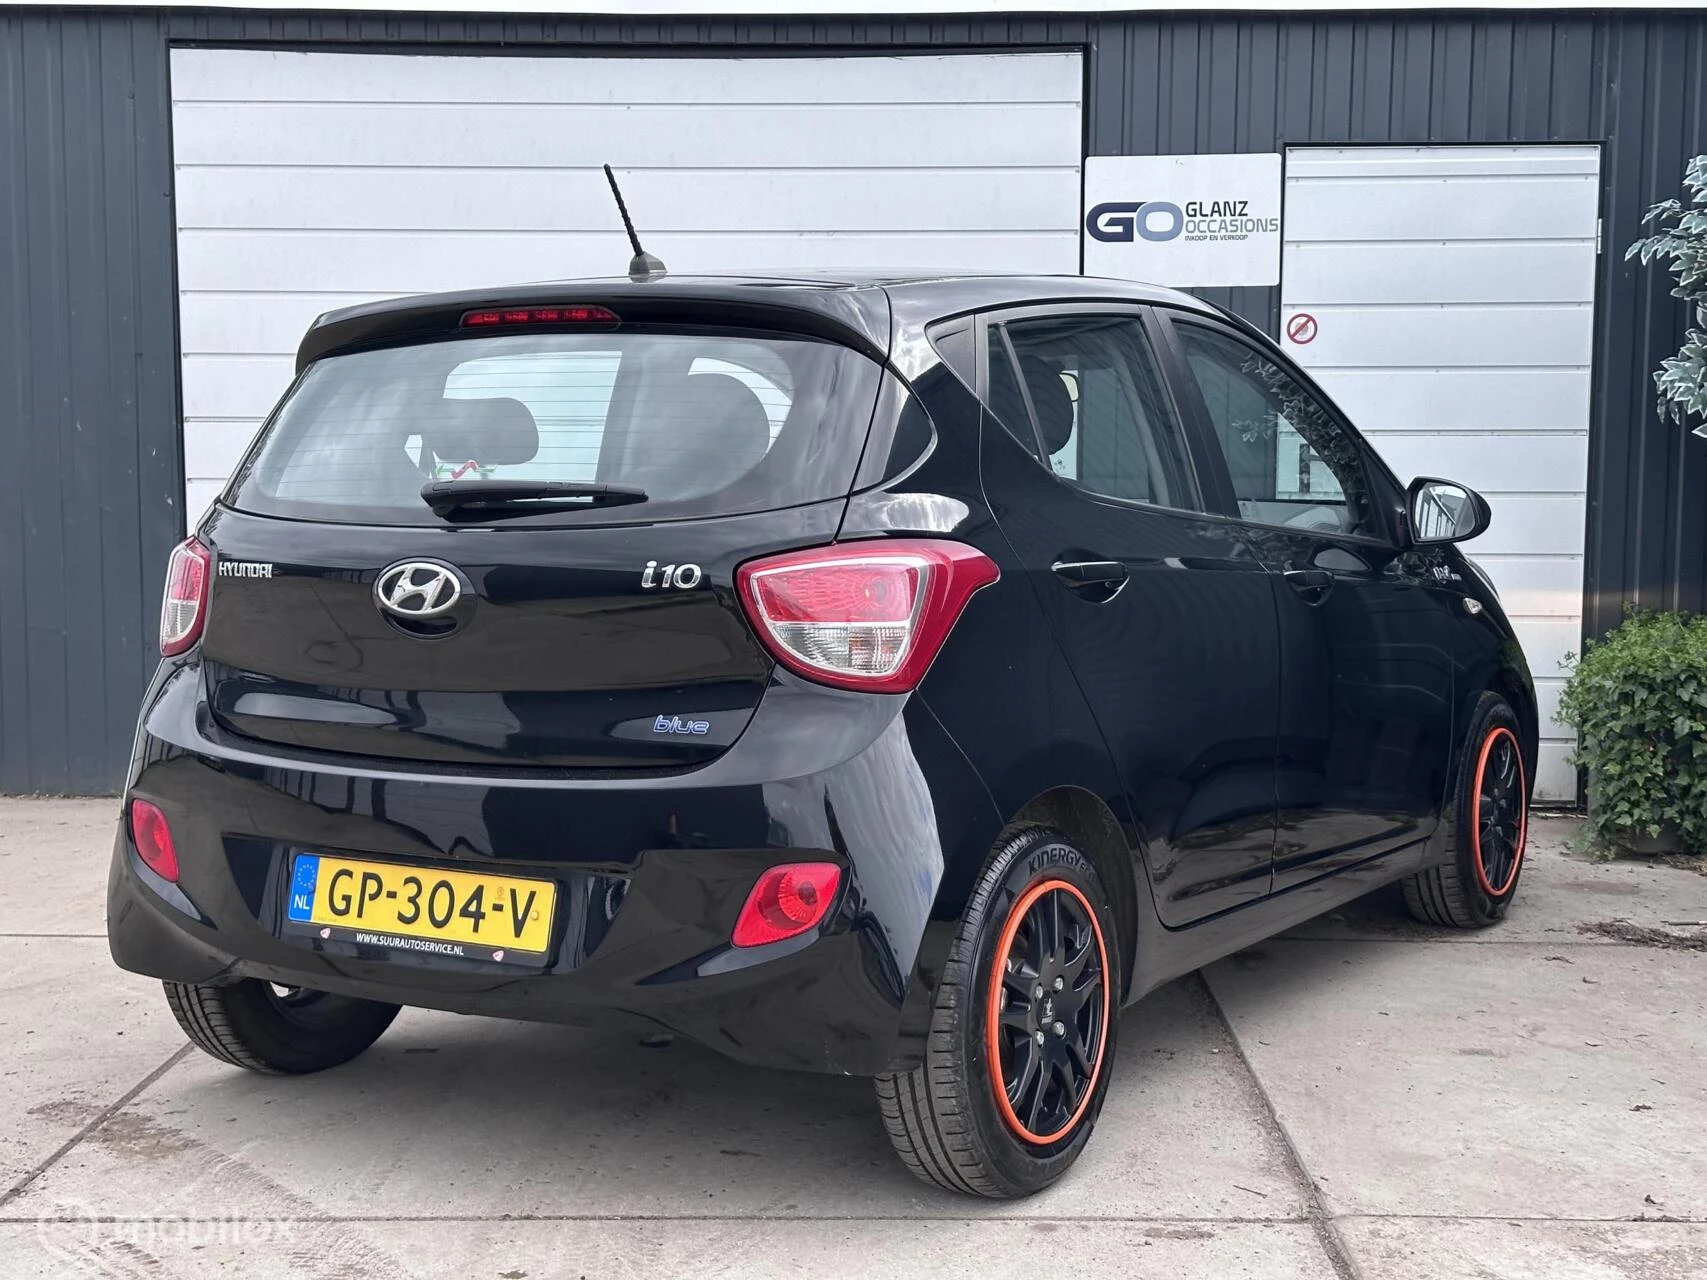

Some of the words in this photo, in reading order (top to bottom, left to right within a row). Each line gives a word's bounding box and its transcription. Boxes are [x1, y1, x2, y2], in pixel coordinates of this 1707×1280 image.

[1185, 201, 1249, 217] GLANZ
[1086, 201, 1184, 242] GO
[1185, 218, 1279, 233] OCCASIONS
[218, 561, 273, 578] HYUNDAI
[641, 560, 702, 589] i10
[653, 714, 710, 735] blue
[1028, 847, 1081, 876] KINERGY
[293, 895, 310, 910] NL
[328, 868, 537, 938] GP-304-V
[356, 932, 465, 956] WWW.SUURAUTOSERVICE.NL
